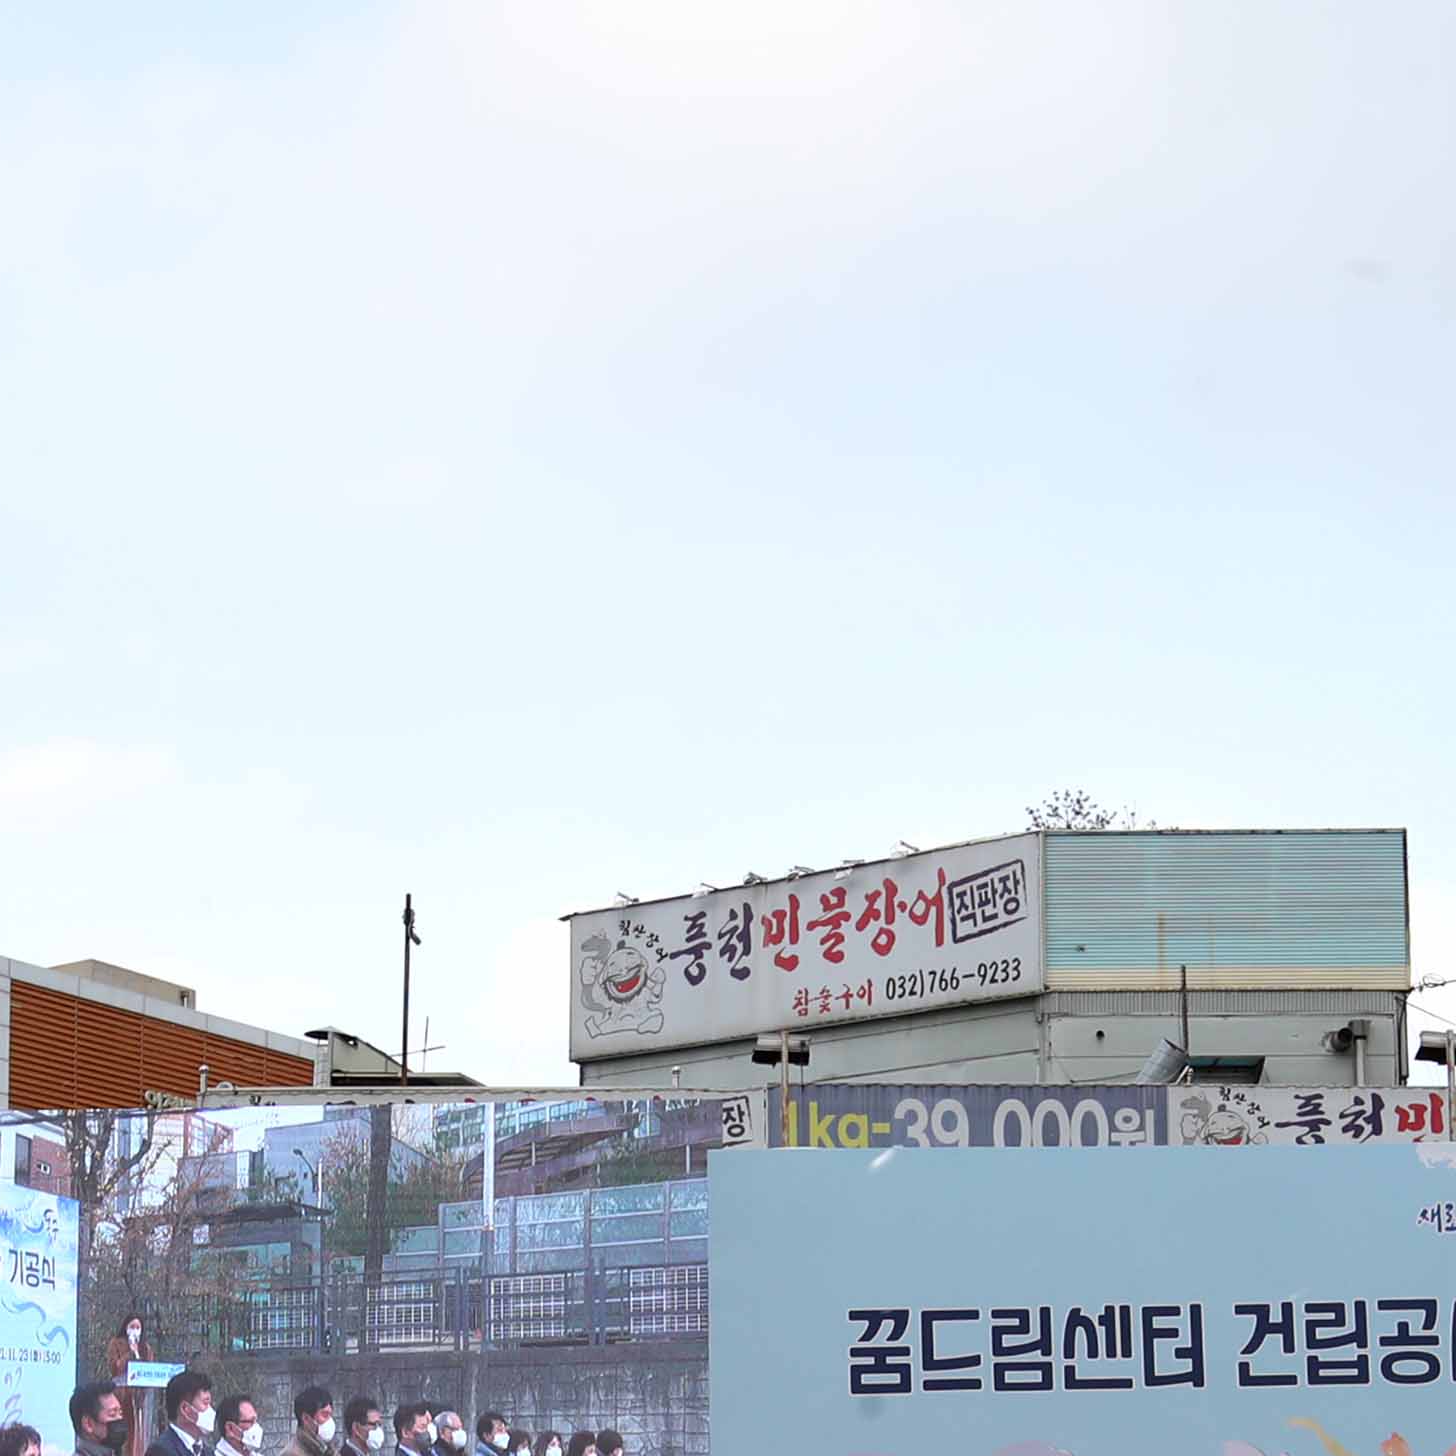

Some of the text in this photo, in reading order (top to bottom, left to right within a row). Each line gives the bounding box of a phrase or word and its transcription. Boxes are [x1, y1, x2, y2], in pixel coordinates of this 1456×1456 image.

[669, 867, 1021, 986] 풍천 민물장어 직판장
[791, 977, 873, 1017] 참숯구이
[885, 957, 1022, 1001] 032)766-9233
[9, 1248, 56, 1292] 기공식
[847, 1302, 1206, 1395] 꿈드림센터
